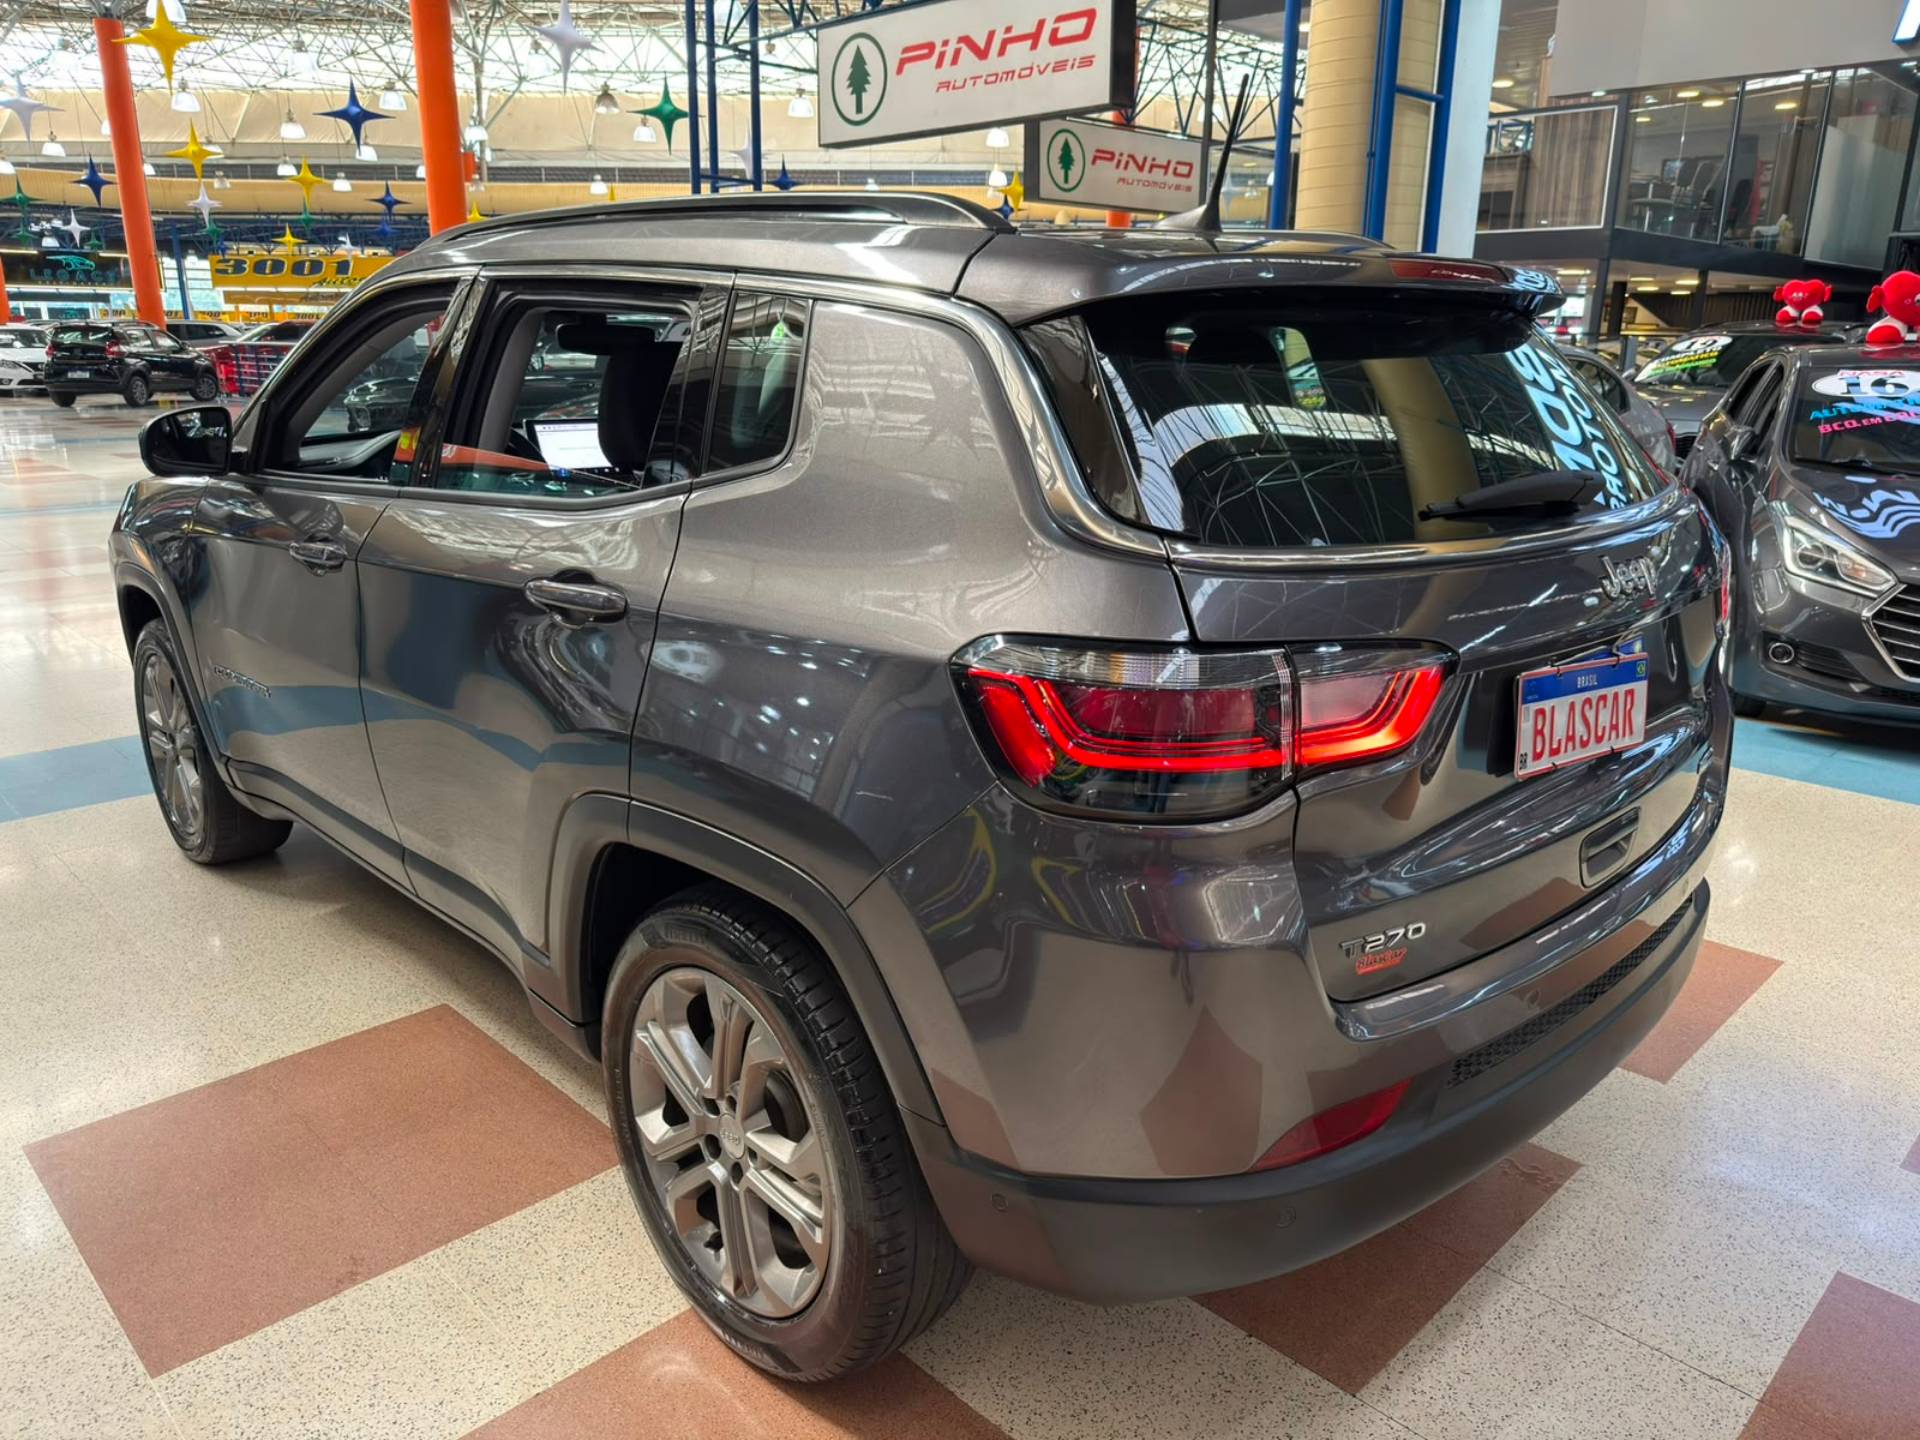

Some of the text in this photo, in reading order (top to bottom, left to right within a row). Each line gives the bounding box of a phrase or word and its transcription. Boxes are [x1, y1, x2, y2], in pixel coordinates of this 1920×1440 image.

[214, 257, 352, 278] 3001
[1839, 376, 1910, 396] 16
[1600, 555, 1657, 598] Jeep
[1576, 672, 1598, 689] BRASIL
[1531, 688, 1636, 763] BLASCAR
[1339, 922, 1426, 960] T270
